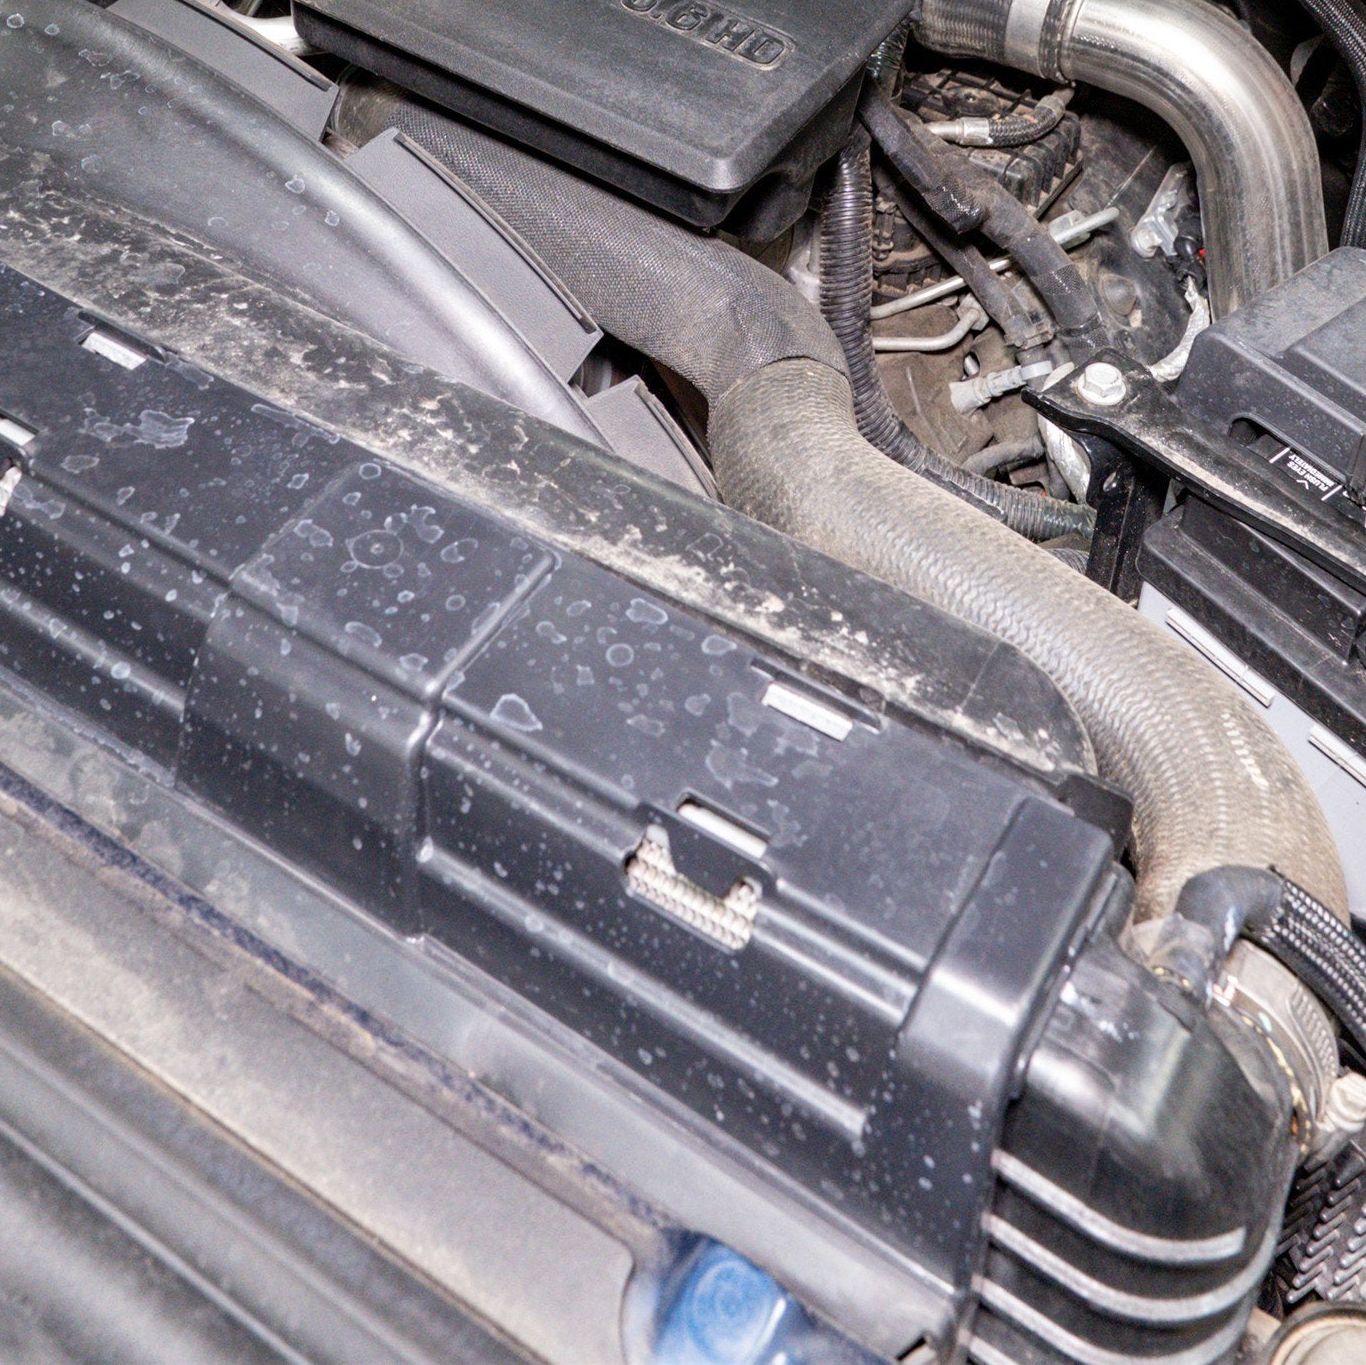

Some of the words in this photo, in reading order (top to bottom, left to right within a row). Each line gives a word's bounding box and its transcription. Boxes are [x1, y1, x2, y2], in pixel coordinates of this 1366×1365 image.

[705, 17, 788, 65] HD
[1286, 460, 1307, 476] EYES
[1288, 453, 1335, 487] IMMEDIATELY
[1303, 472, 1329, 492] FLUSH
